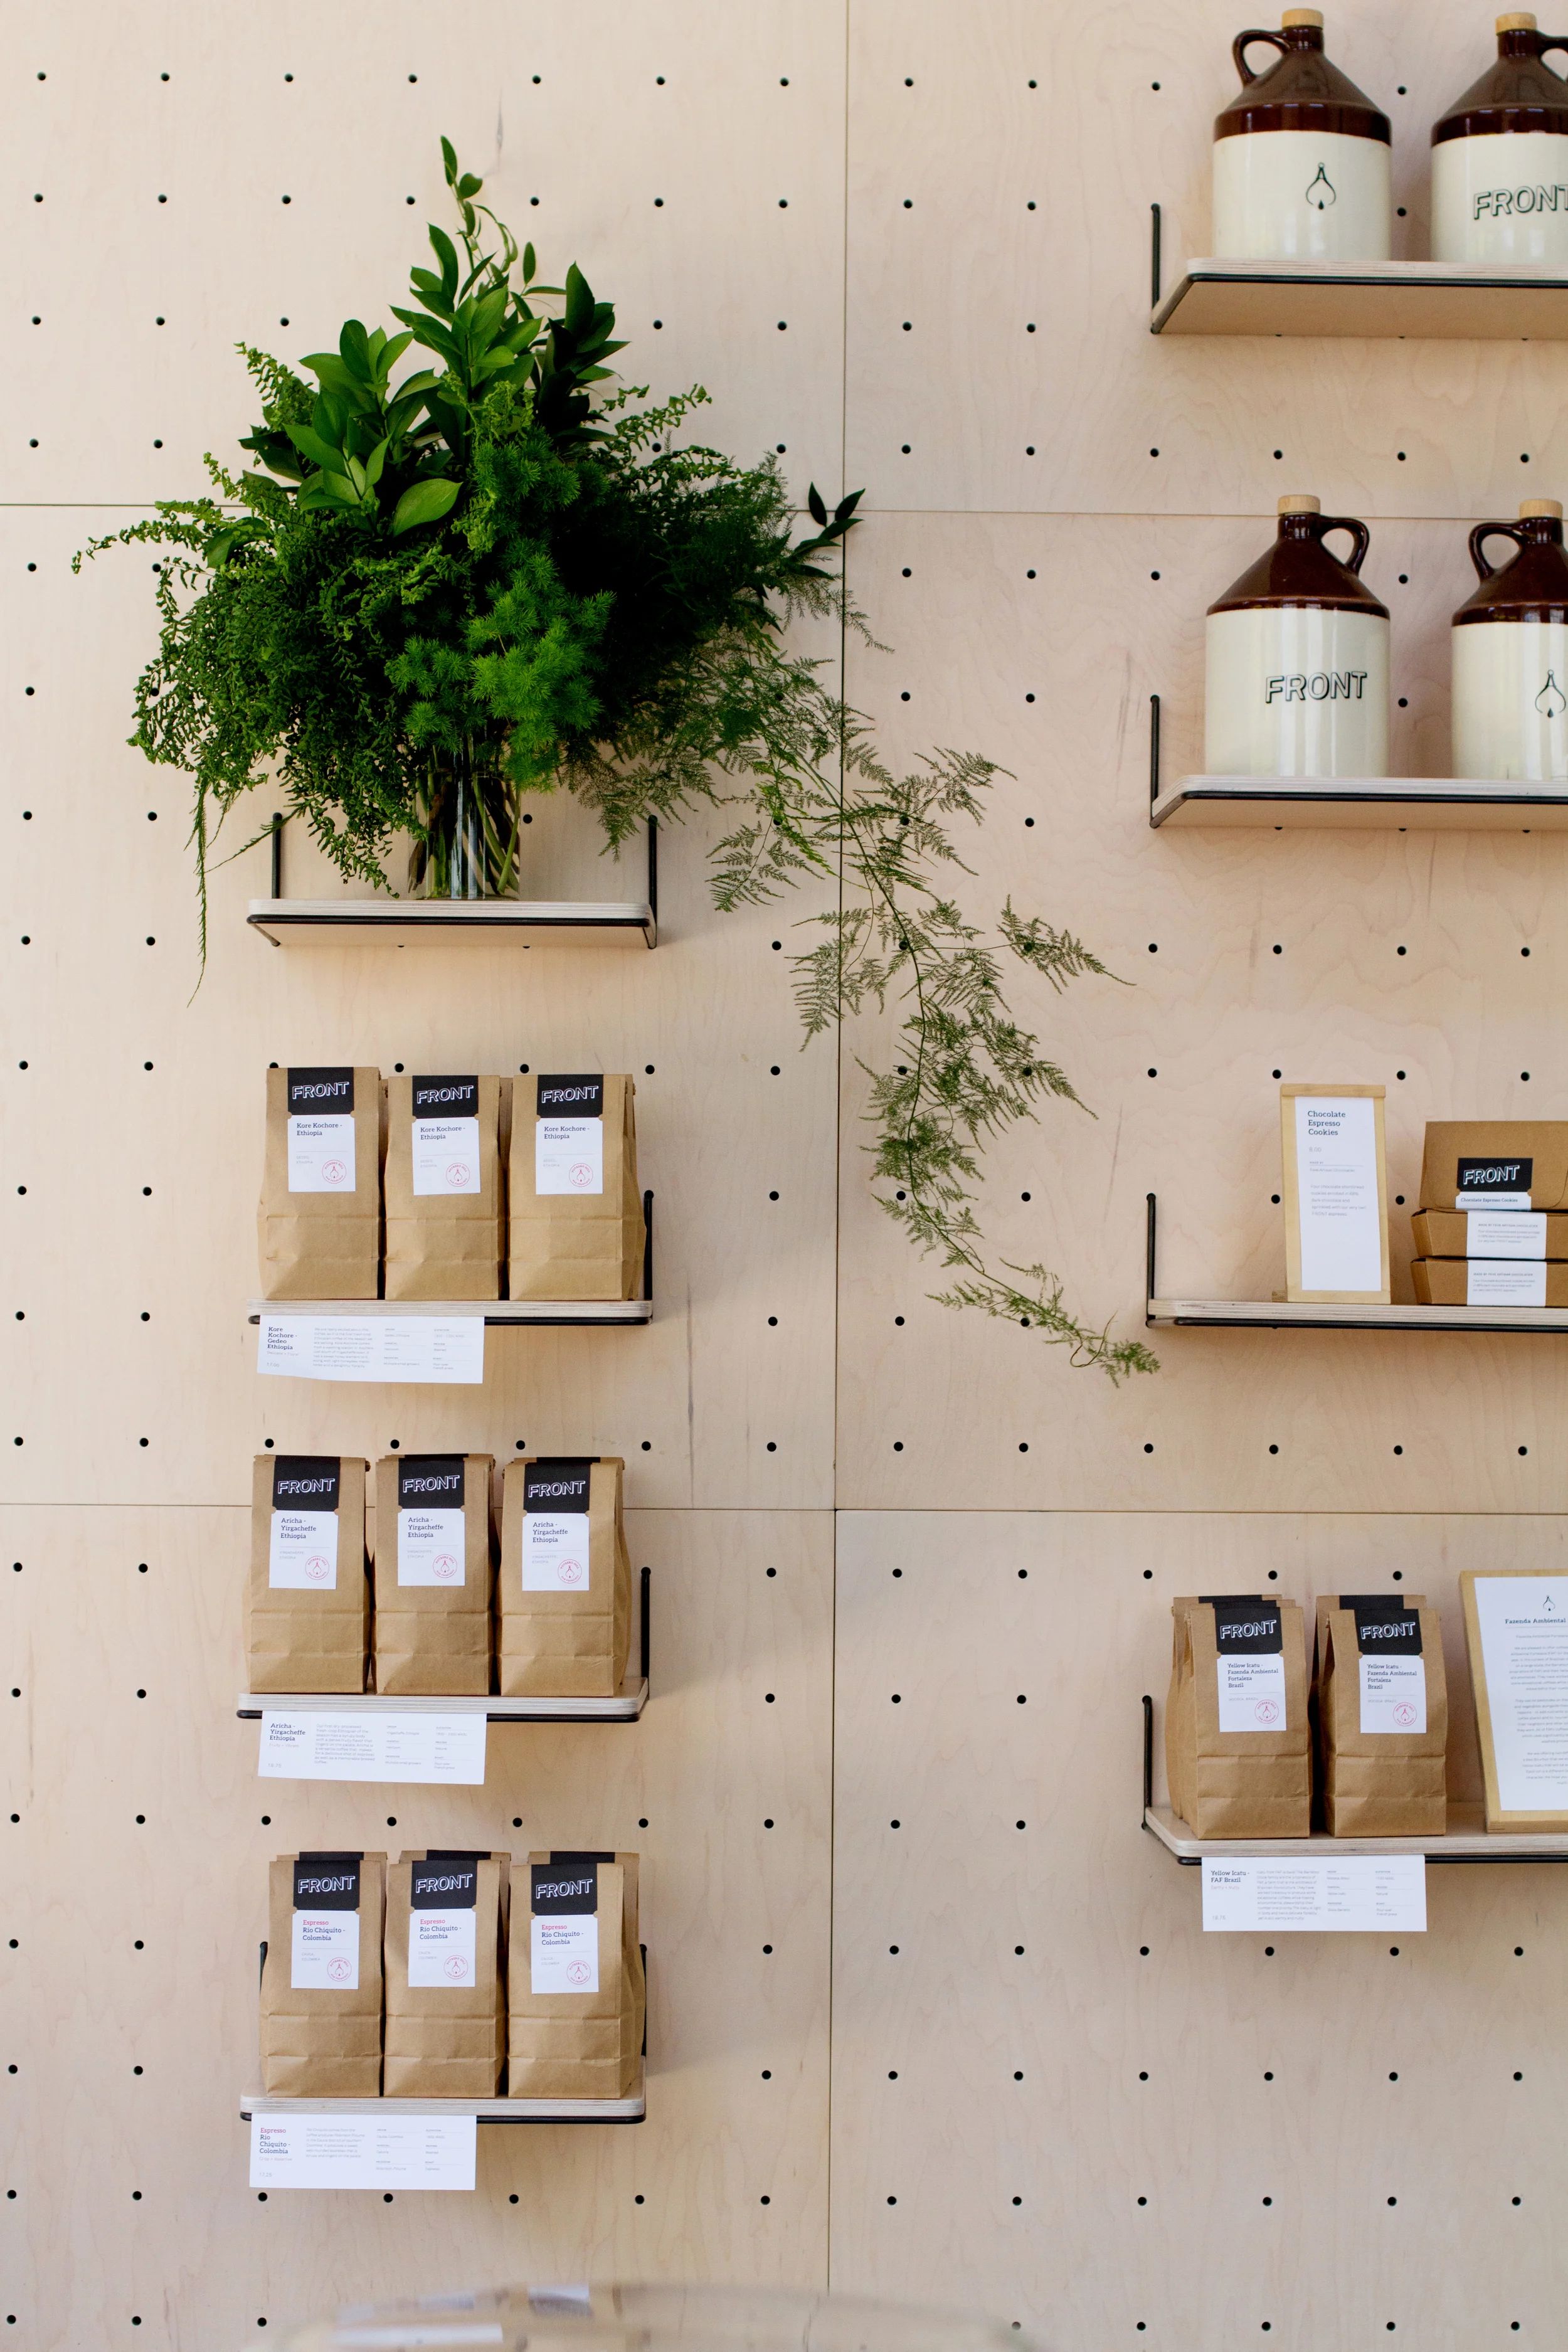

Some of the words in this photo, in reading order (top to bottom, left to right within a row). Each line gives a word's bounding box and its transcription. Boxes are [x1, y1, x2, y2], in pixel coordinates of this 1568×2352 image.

[1266, 670, 1368, 704] FRONT
[292, 1081, 349, 1099] FRONT
[416, 1085, 474, 1104] FRONT
[541, 1086, 598, 1103] FRONT
[1308, 1120, 1340, 1128] Espresso
[1463, 1165, 1520, 1185] FRONT
[277, 1478, 336, 1494] FRONT
[403, 1475, 460, 1493] FRONT
[528, 1481, 586, 1498] FRONT
[1220, 1619, 1277, 1639] FRONT
[1360, 1622, 1416, 1640] FRONT
[298, 1875, 356, 1894] FRONT
[415, 1873, 473, 1893] FRONT
[536, 1878, 593, 1899] FRONT
